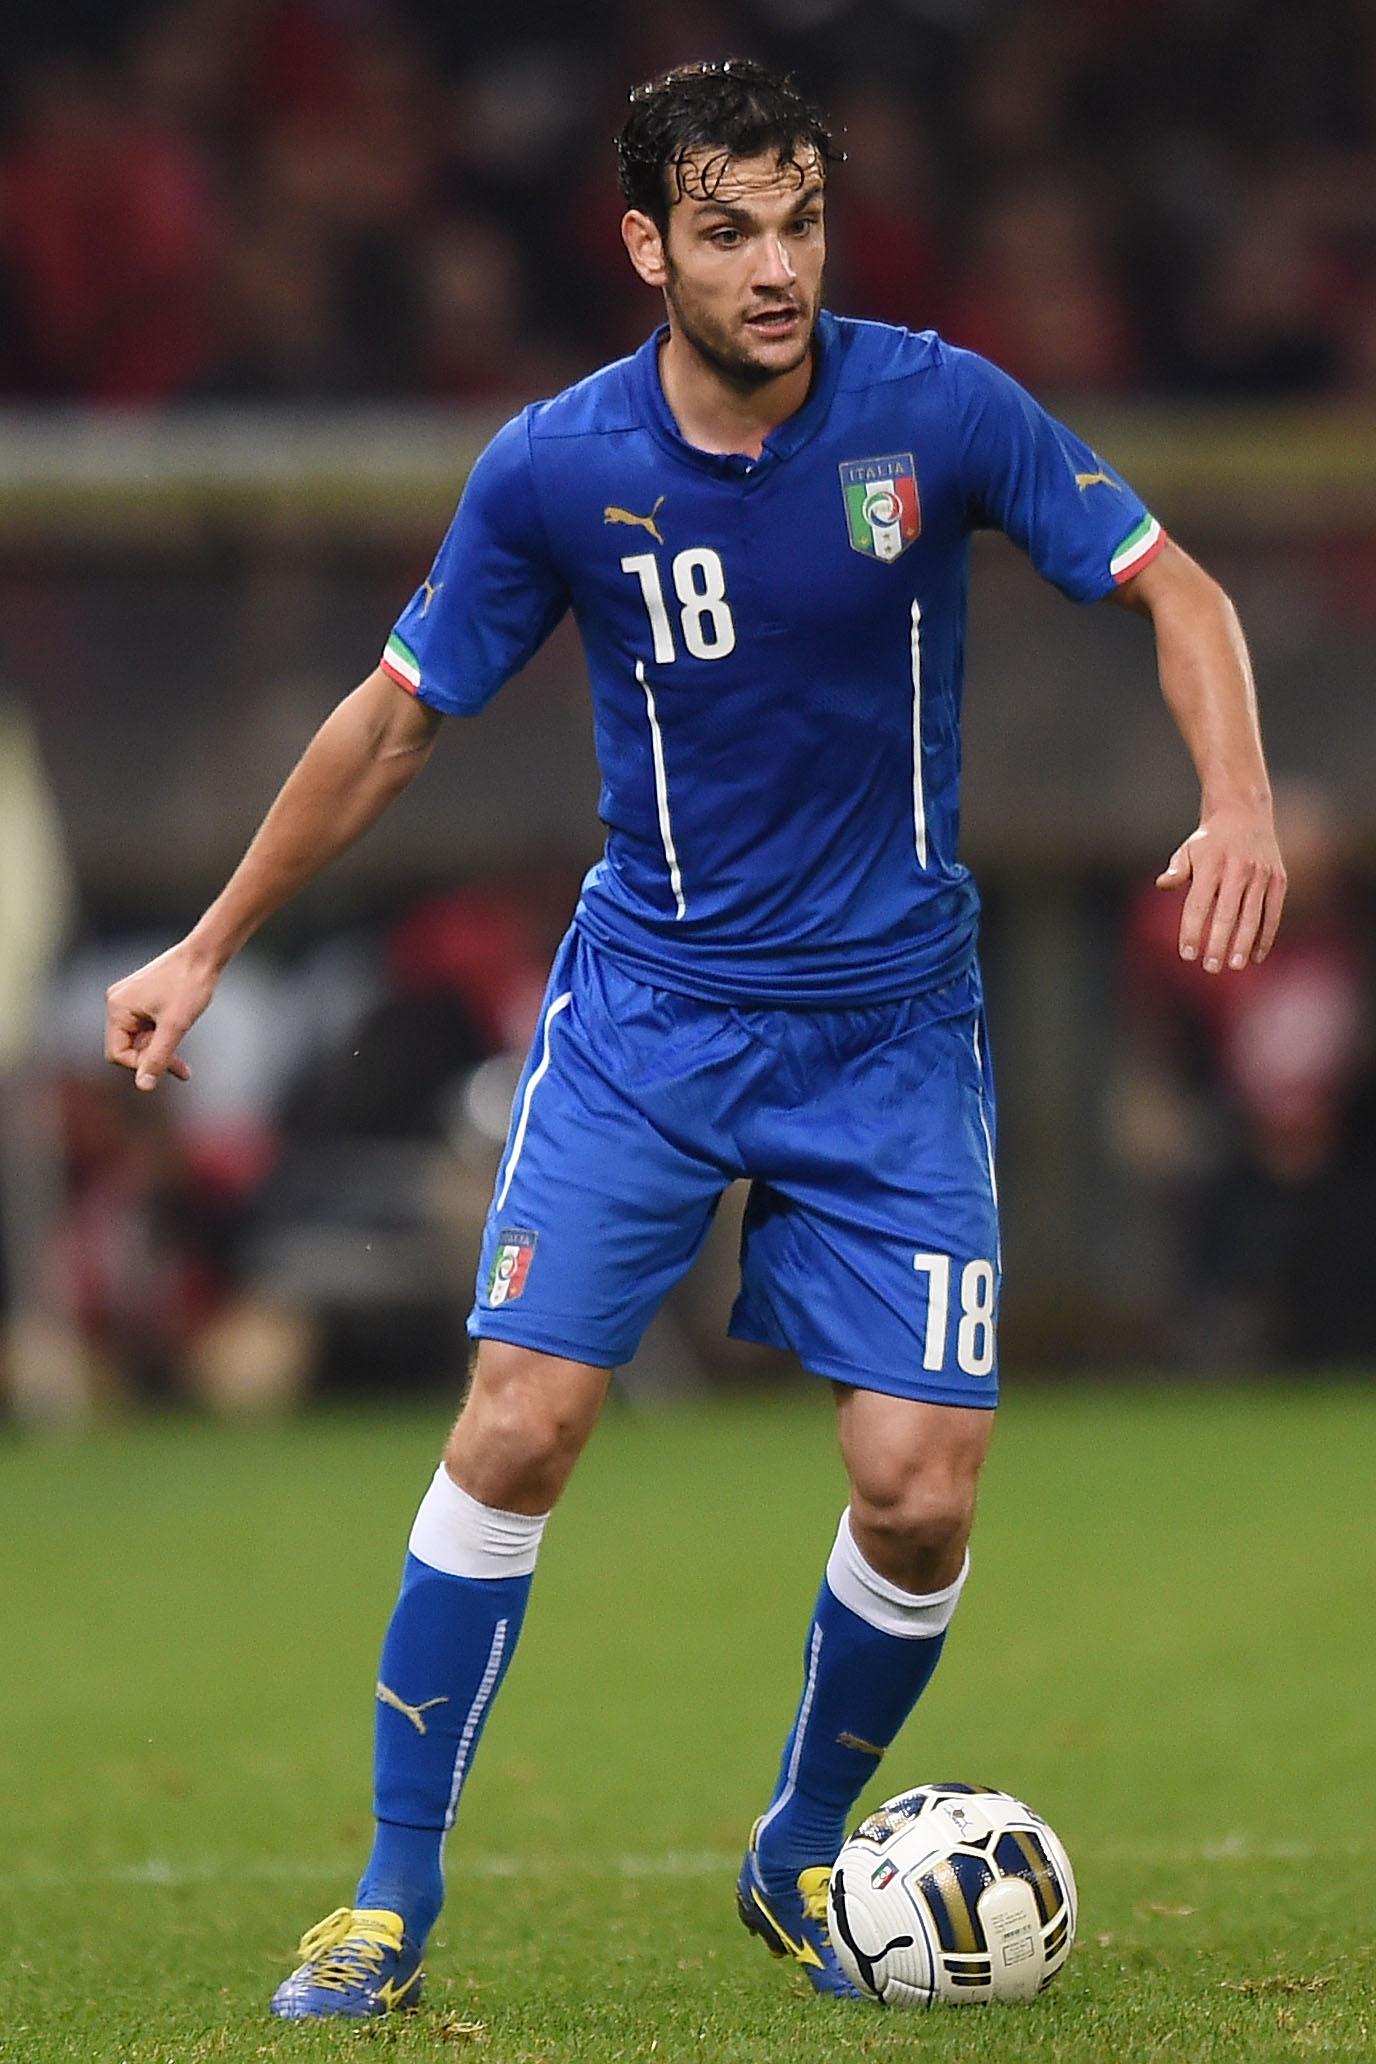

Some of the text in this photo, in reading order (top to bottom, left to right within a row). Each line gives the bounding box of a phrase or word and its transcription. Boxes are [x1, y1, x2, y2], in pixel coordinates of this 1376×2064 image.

[849, 462, 904, 481] ITALIA
[620, 547, 736, 664] 18
[913, 1253, 994, 1377] 18
